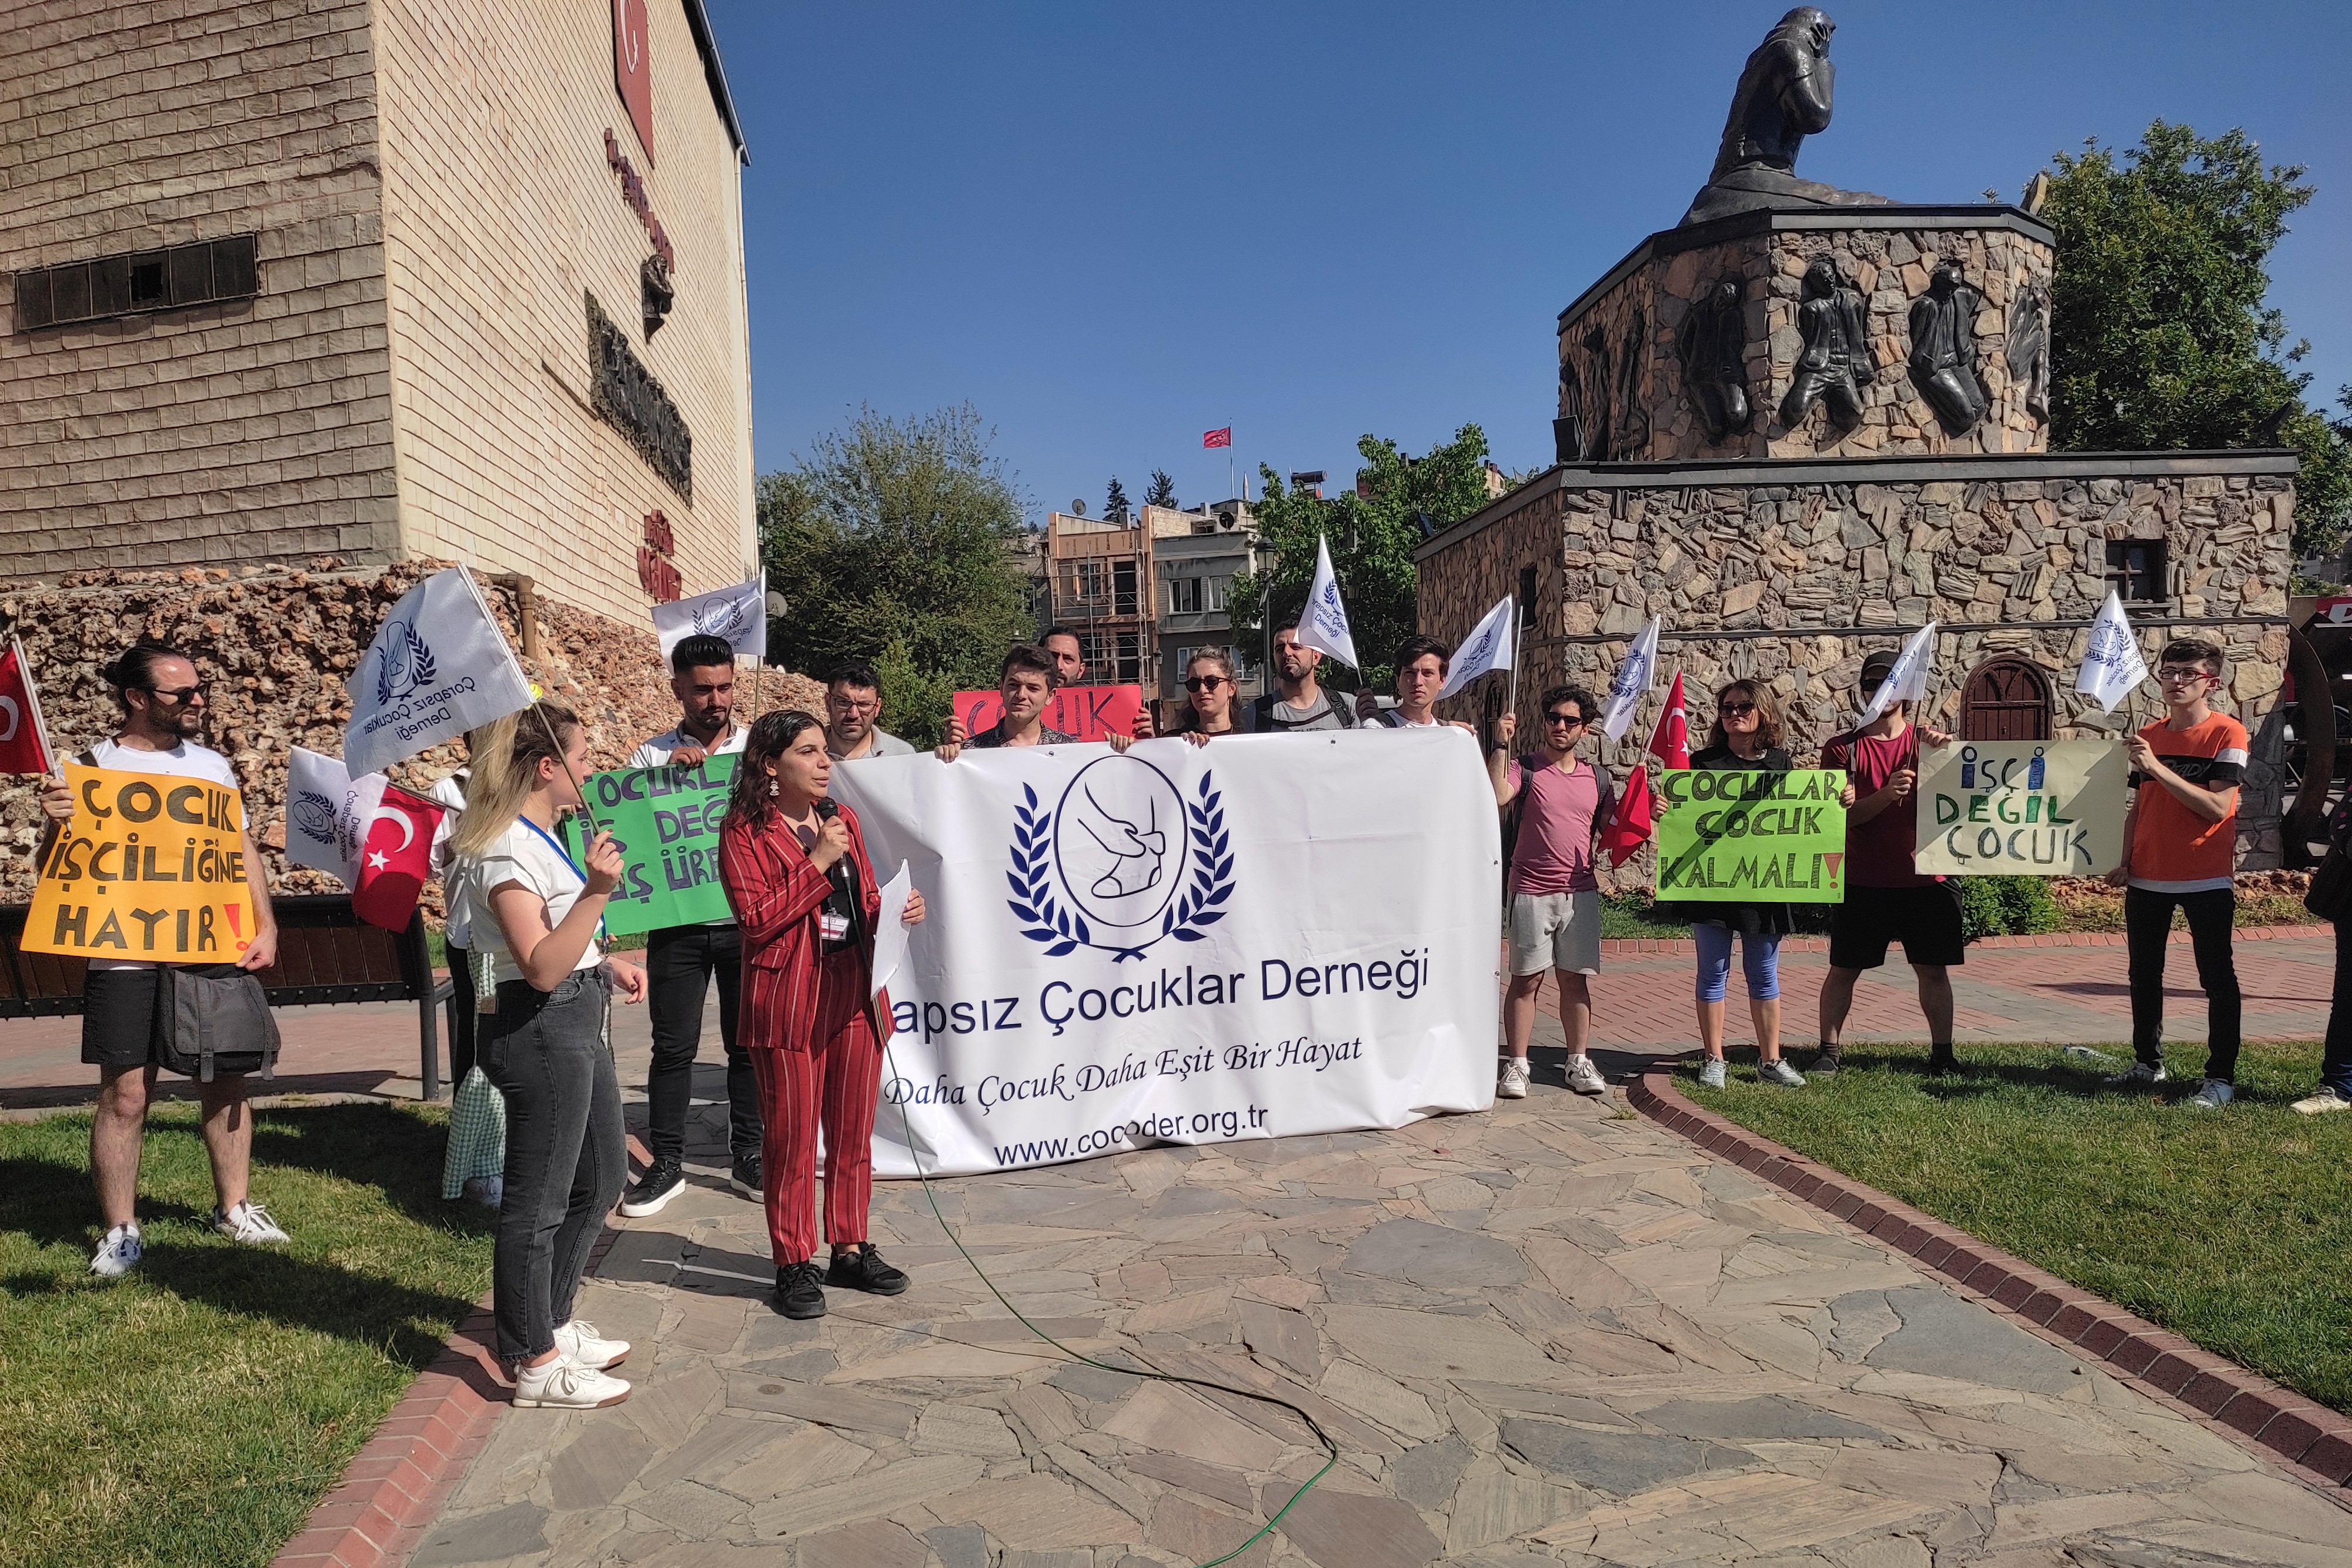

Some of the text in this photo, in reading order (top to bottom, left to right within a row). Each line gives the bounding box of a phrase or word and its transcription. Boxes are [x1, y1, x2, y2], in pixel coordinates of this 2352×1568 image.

[1663, 771, 1840, 810] ÇOCUKLAR
[1960, 745, 2045, 793] İŞÇİ
[82, 779, 238, 833] ÇOCUK
[1695, 807, 1824, 845] ÇOCUK
[45, 830, 248, 895] İŞÇİLİĞİNE
[1947, 825, 2093, 865] ÇOCUK
[1661, 852, 1844, 890] KALMALI!
[53, 903, 249, 952] HAYIR!
[1040, 965, 1245, 1037] Çocuklar
[1261, 947, 1428, 1001] Derneği
[884, 1037, 1362, 1116] Daha Çocuk Daha Eşit Bir Hayat
